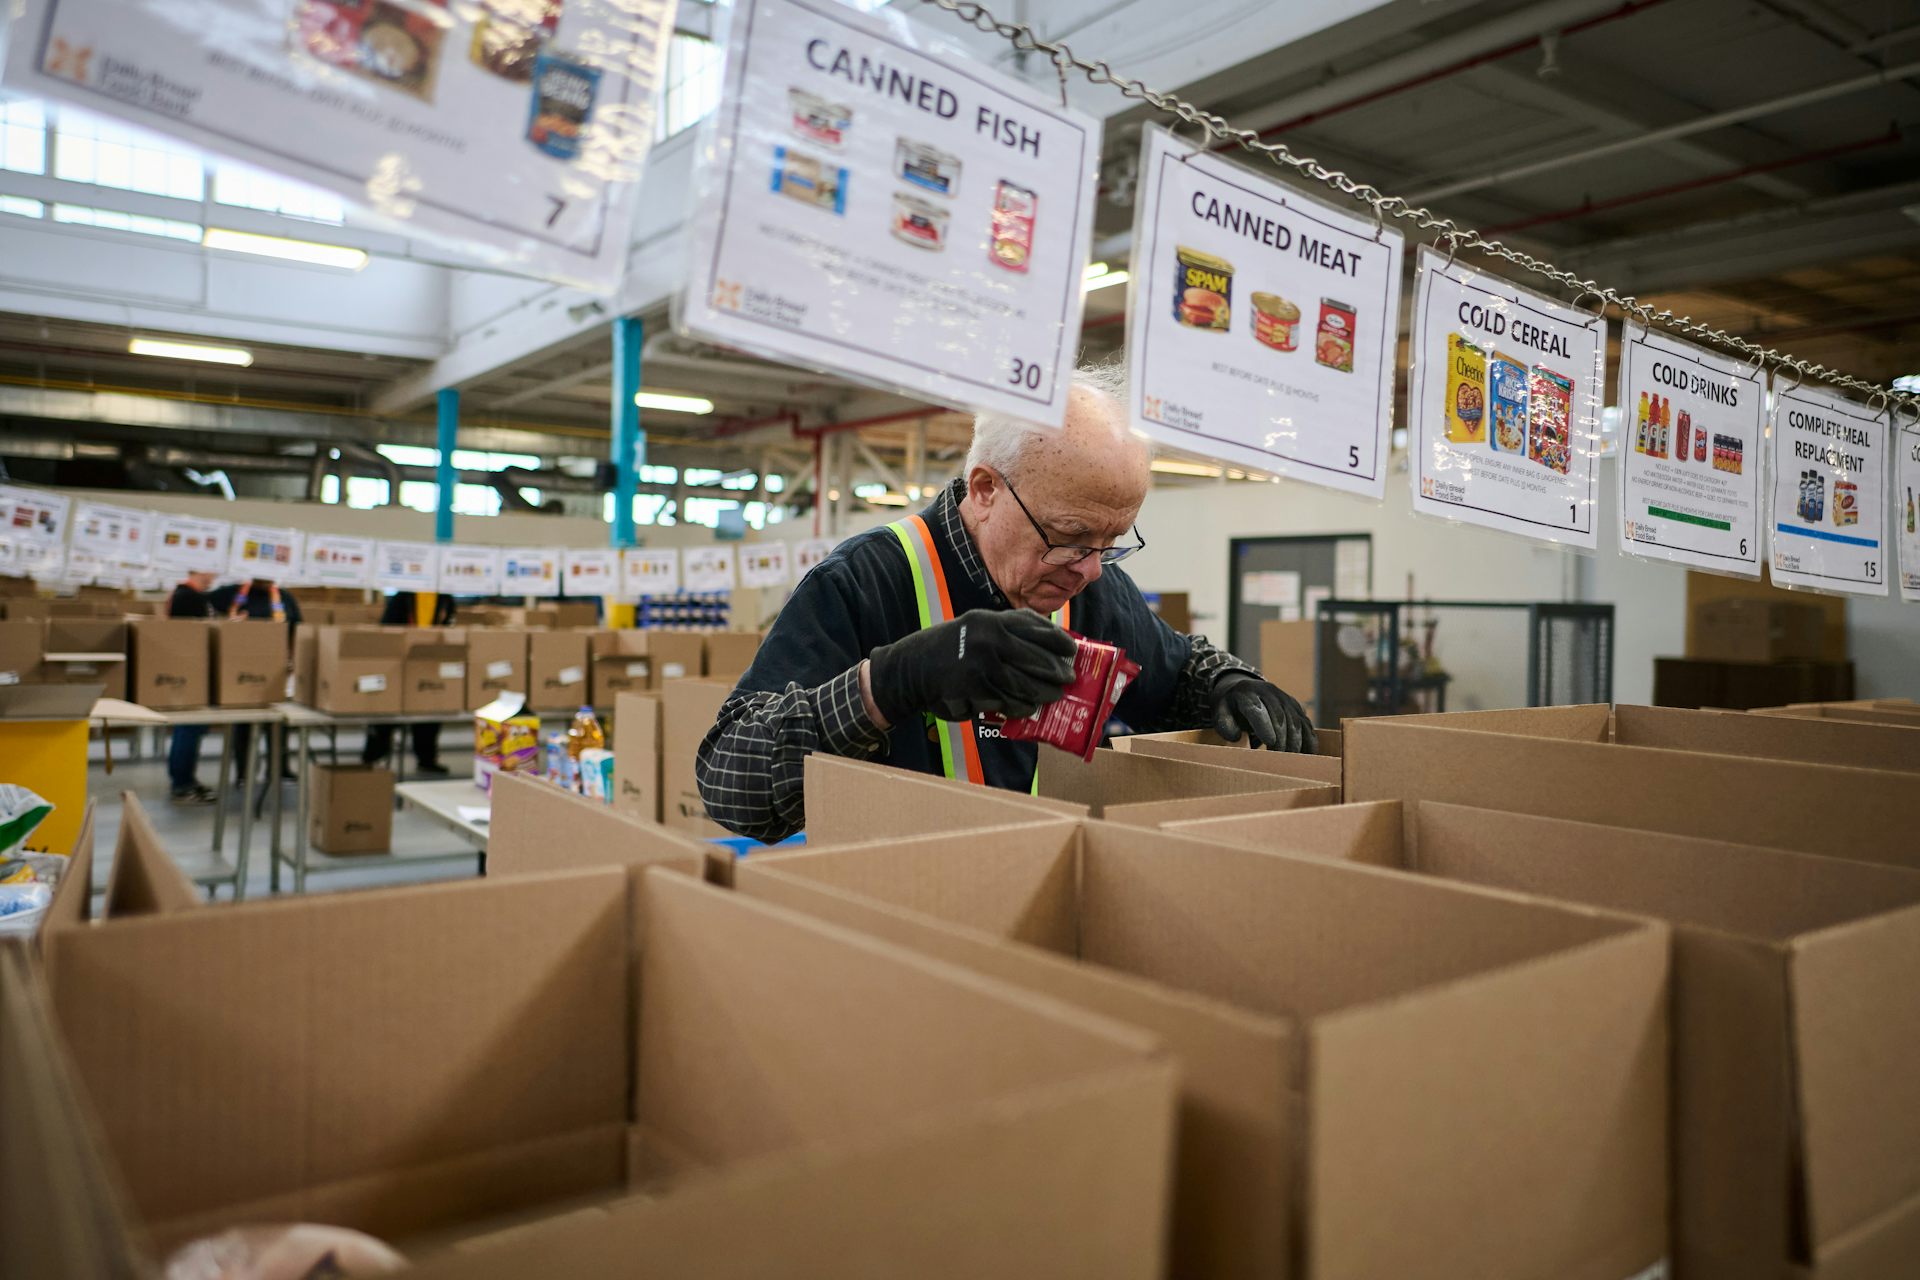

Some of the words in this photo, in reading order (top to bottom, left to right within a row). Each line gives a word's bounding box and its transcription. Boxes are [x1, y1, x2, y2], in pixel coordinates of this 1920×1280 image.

[806, 38, 958, 120] CANNED
[976, 106, 1041, 159] FISH
[547, 197, 566, 228] 7
[1191, 190, 1292, 251] CANNED
[1299, 233, 1362, 278] MEAT
[1185, 268, 1228, 294] SPAM
[1458, 301, 1505, 336] COLD
[1511, 319, 1571, 359] CEREAL
[1008, 357, 1041, 390] 30
[1456, 356, 1485, 385] Cheerios
[1652, 362, 1688, 391] COLD
[1689, 374, 1738, 408] DRINKS
[1789, 411, 1842, 441] COMPLETE
[1843, 424, 1870, 448] MEAL
[1349, 446, 1360, 468] 5
[1795, 440, 1865, 473] REPLACEMENT
[1449, 484, 1465, 494] Bread
[1450, 492, 1463, 502] Bank
[1570, 503, 1576, 523] 1
[1740, 538, 1747, 556] 6
[1864, 561, 1876, 578] 15
[978, 726, 1008, 739] Foo
